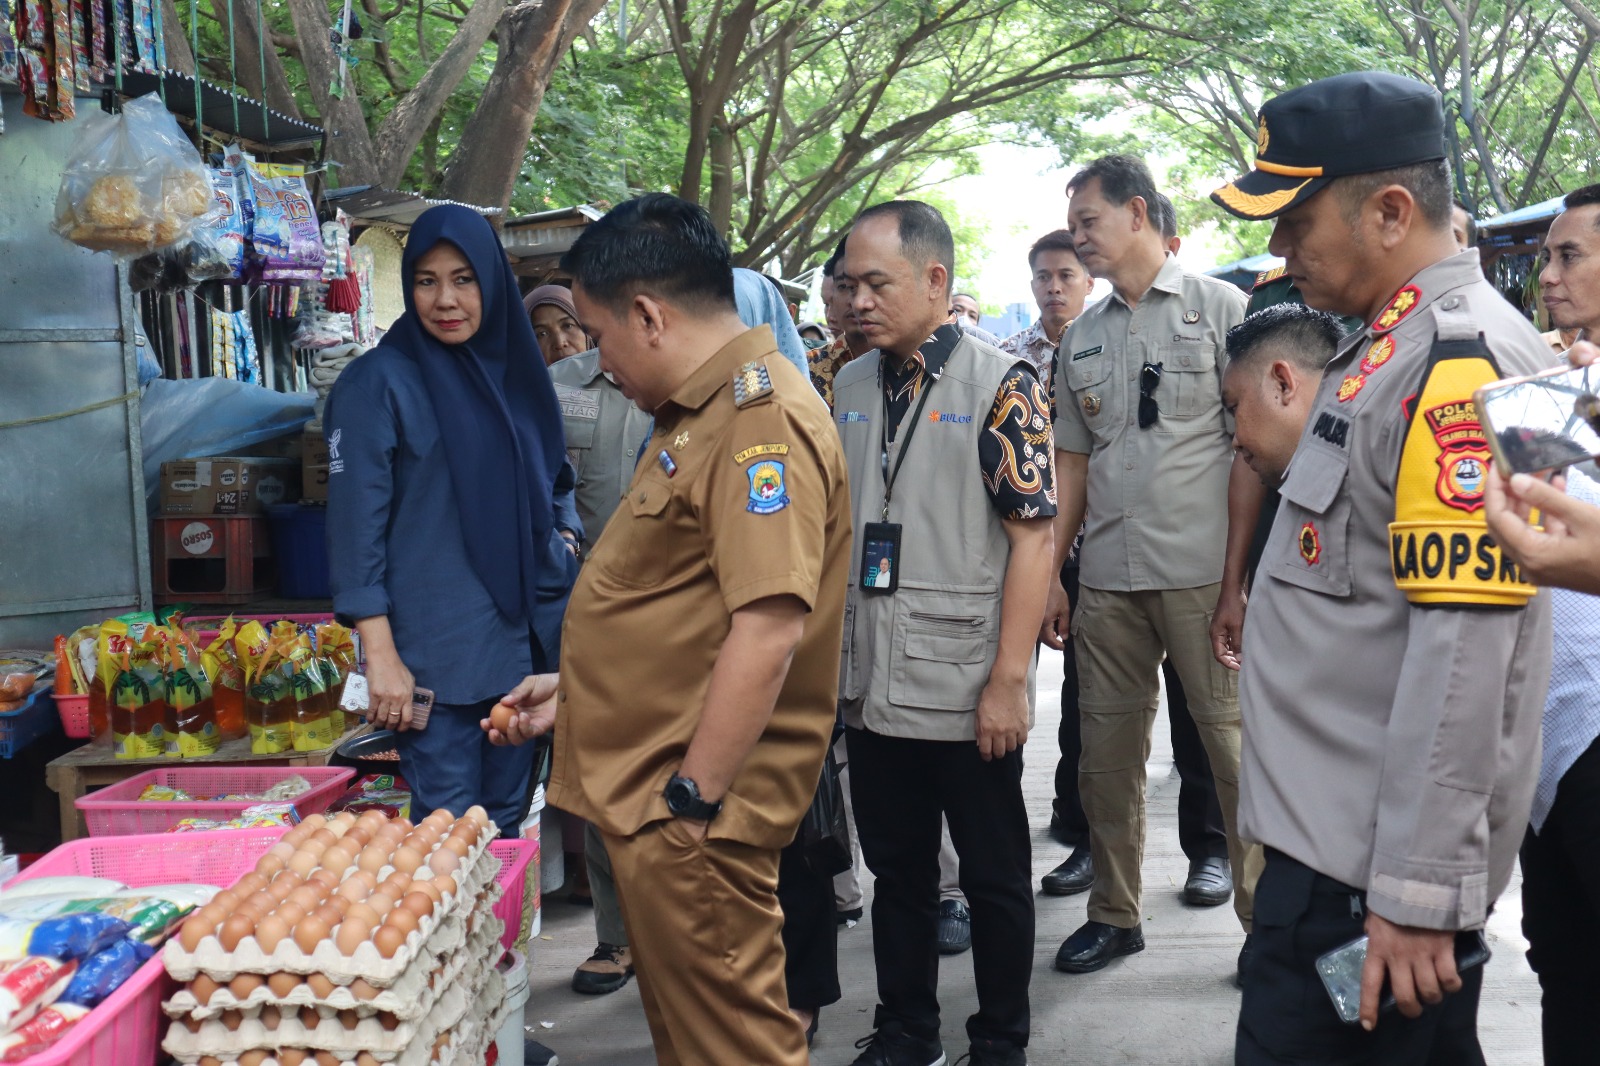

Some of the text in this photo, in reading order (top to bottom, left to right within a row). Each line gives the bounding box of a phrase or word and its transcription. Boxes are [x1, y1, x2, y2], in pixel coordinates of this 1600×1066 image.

[940, 413, 972, 423] BULOG
[1433, 402, 1475, 421] POLR
[1440, 413, 1479, 426] JENEPON
[1313, 411, 1350, 449] POLRI
[217, 492, 236, 504] 24+1
[183, 529, 213, 547] SOSRO
[1393, 532, 1528, 584] KAOPSR
